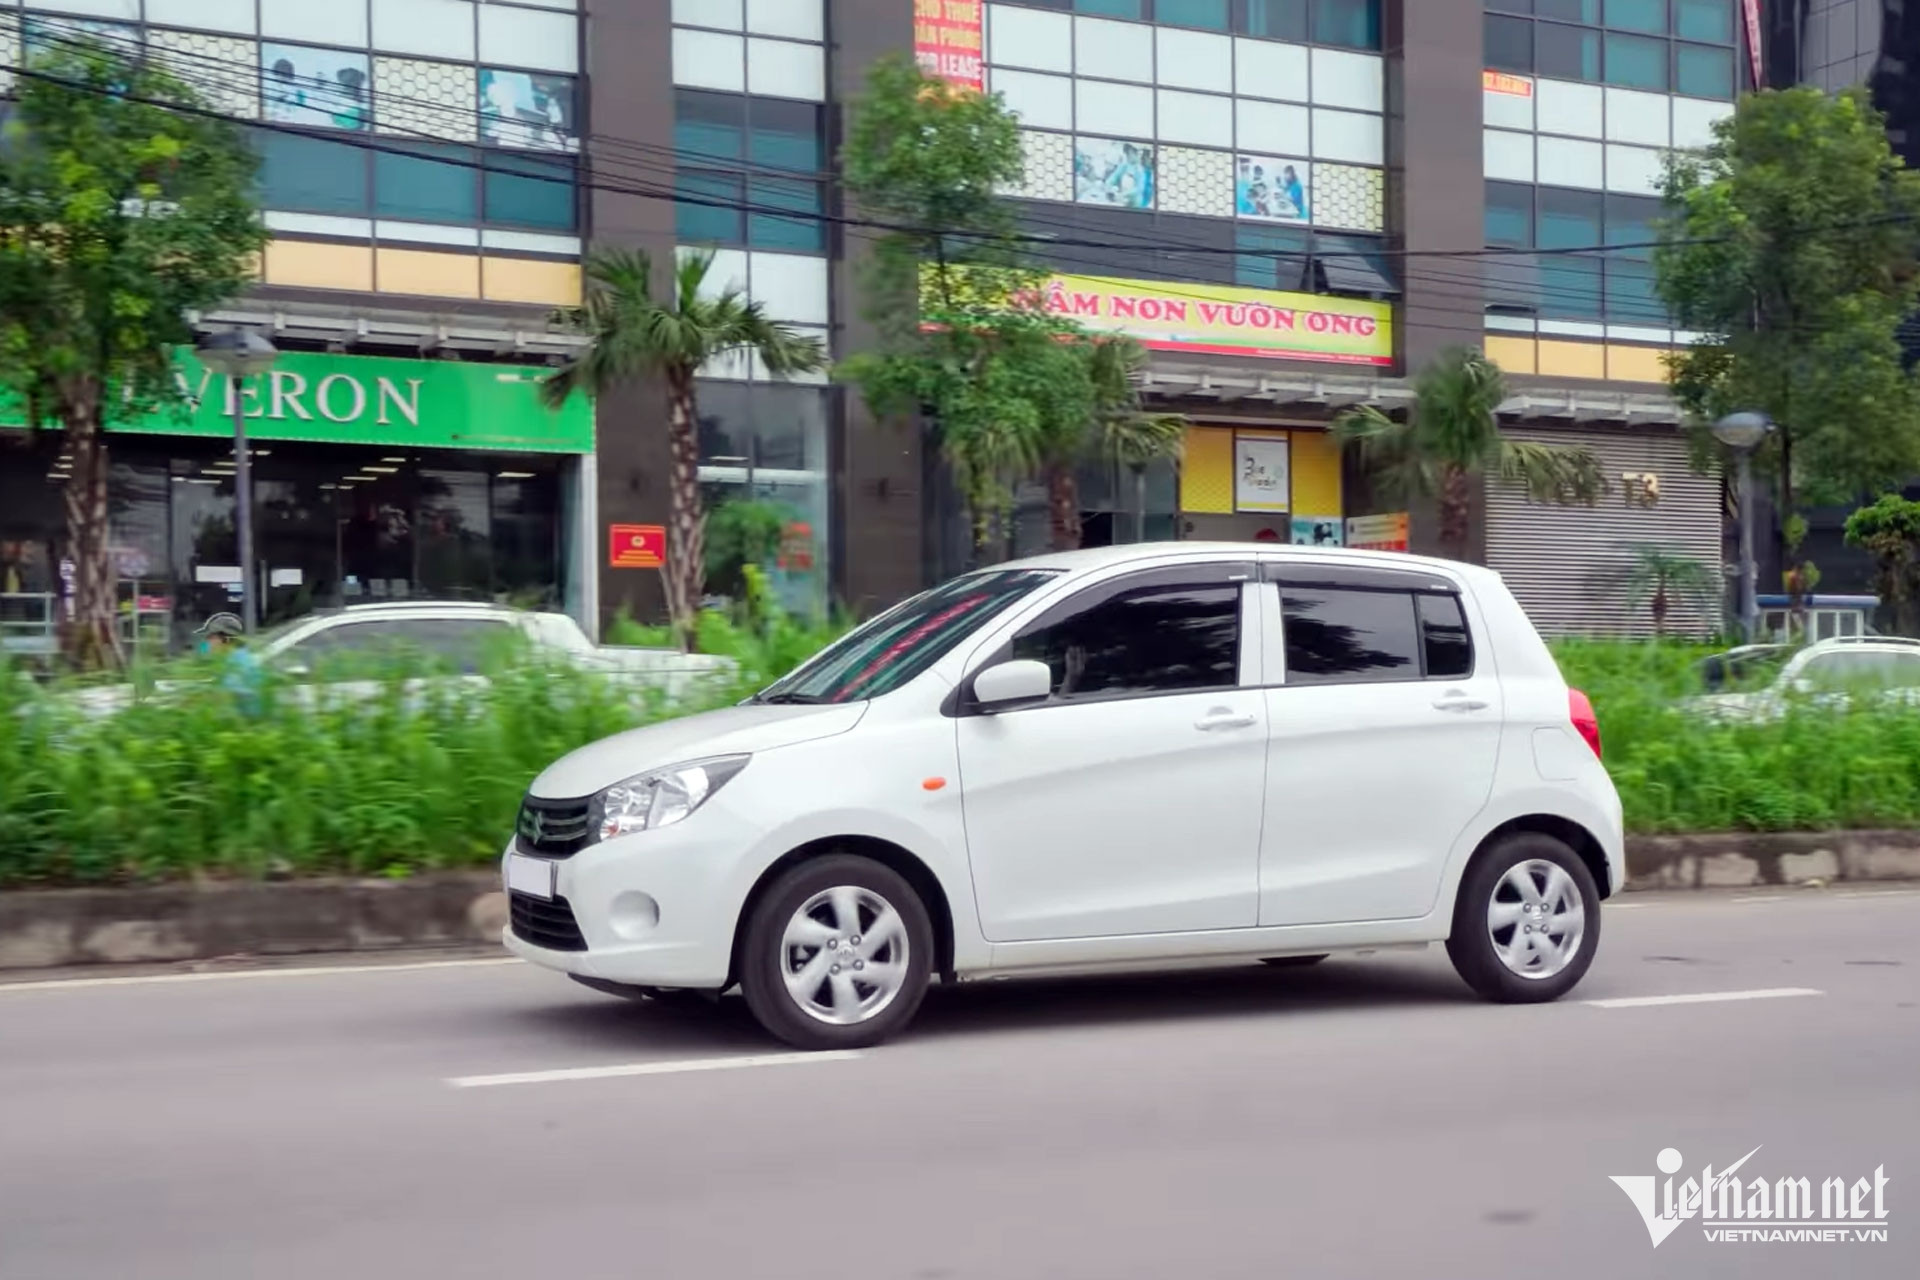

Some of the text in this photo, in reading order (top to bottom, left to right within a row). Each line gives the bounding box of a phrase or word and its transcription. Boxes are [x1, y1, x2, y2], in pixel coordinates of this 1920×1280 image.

[941, 53, 981, 80] LEASE
[1111, 295, 1187, 321] NON
[1307, 311, 1376, 336] ONG
